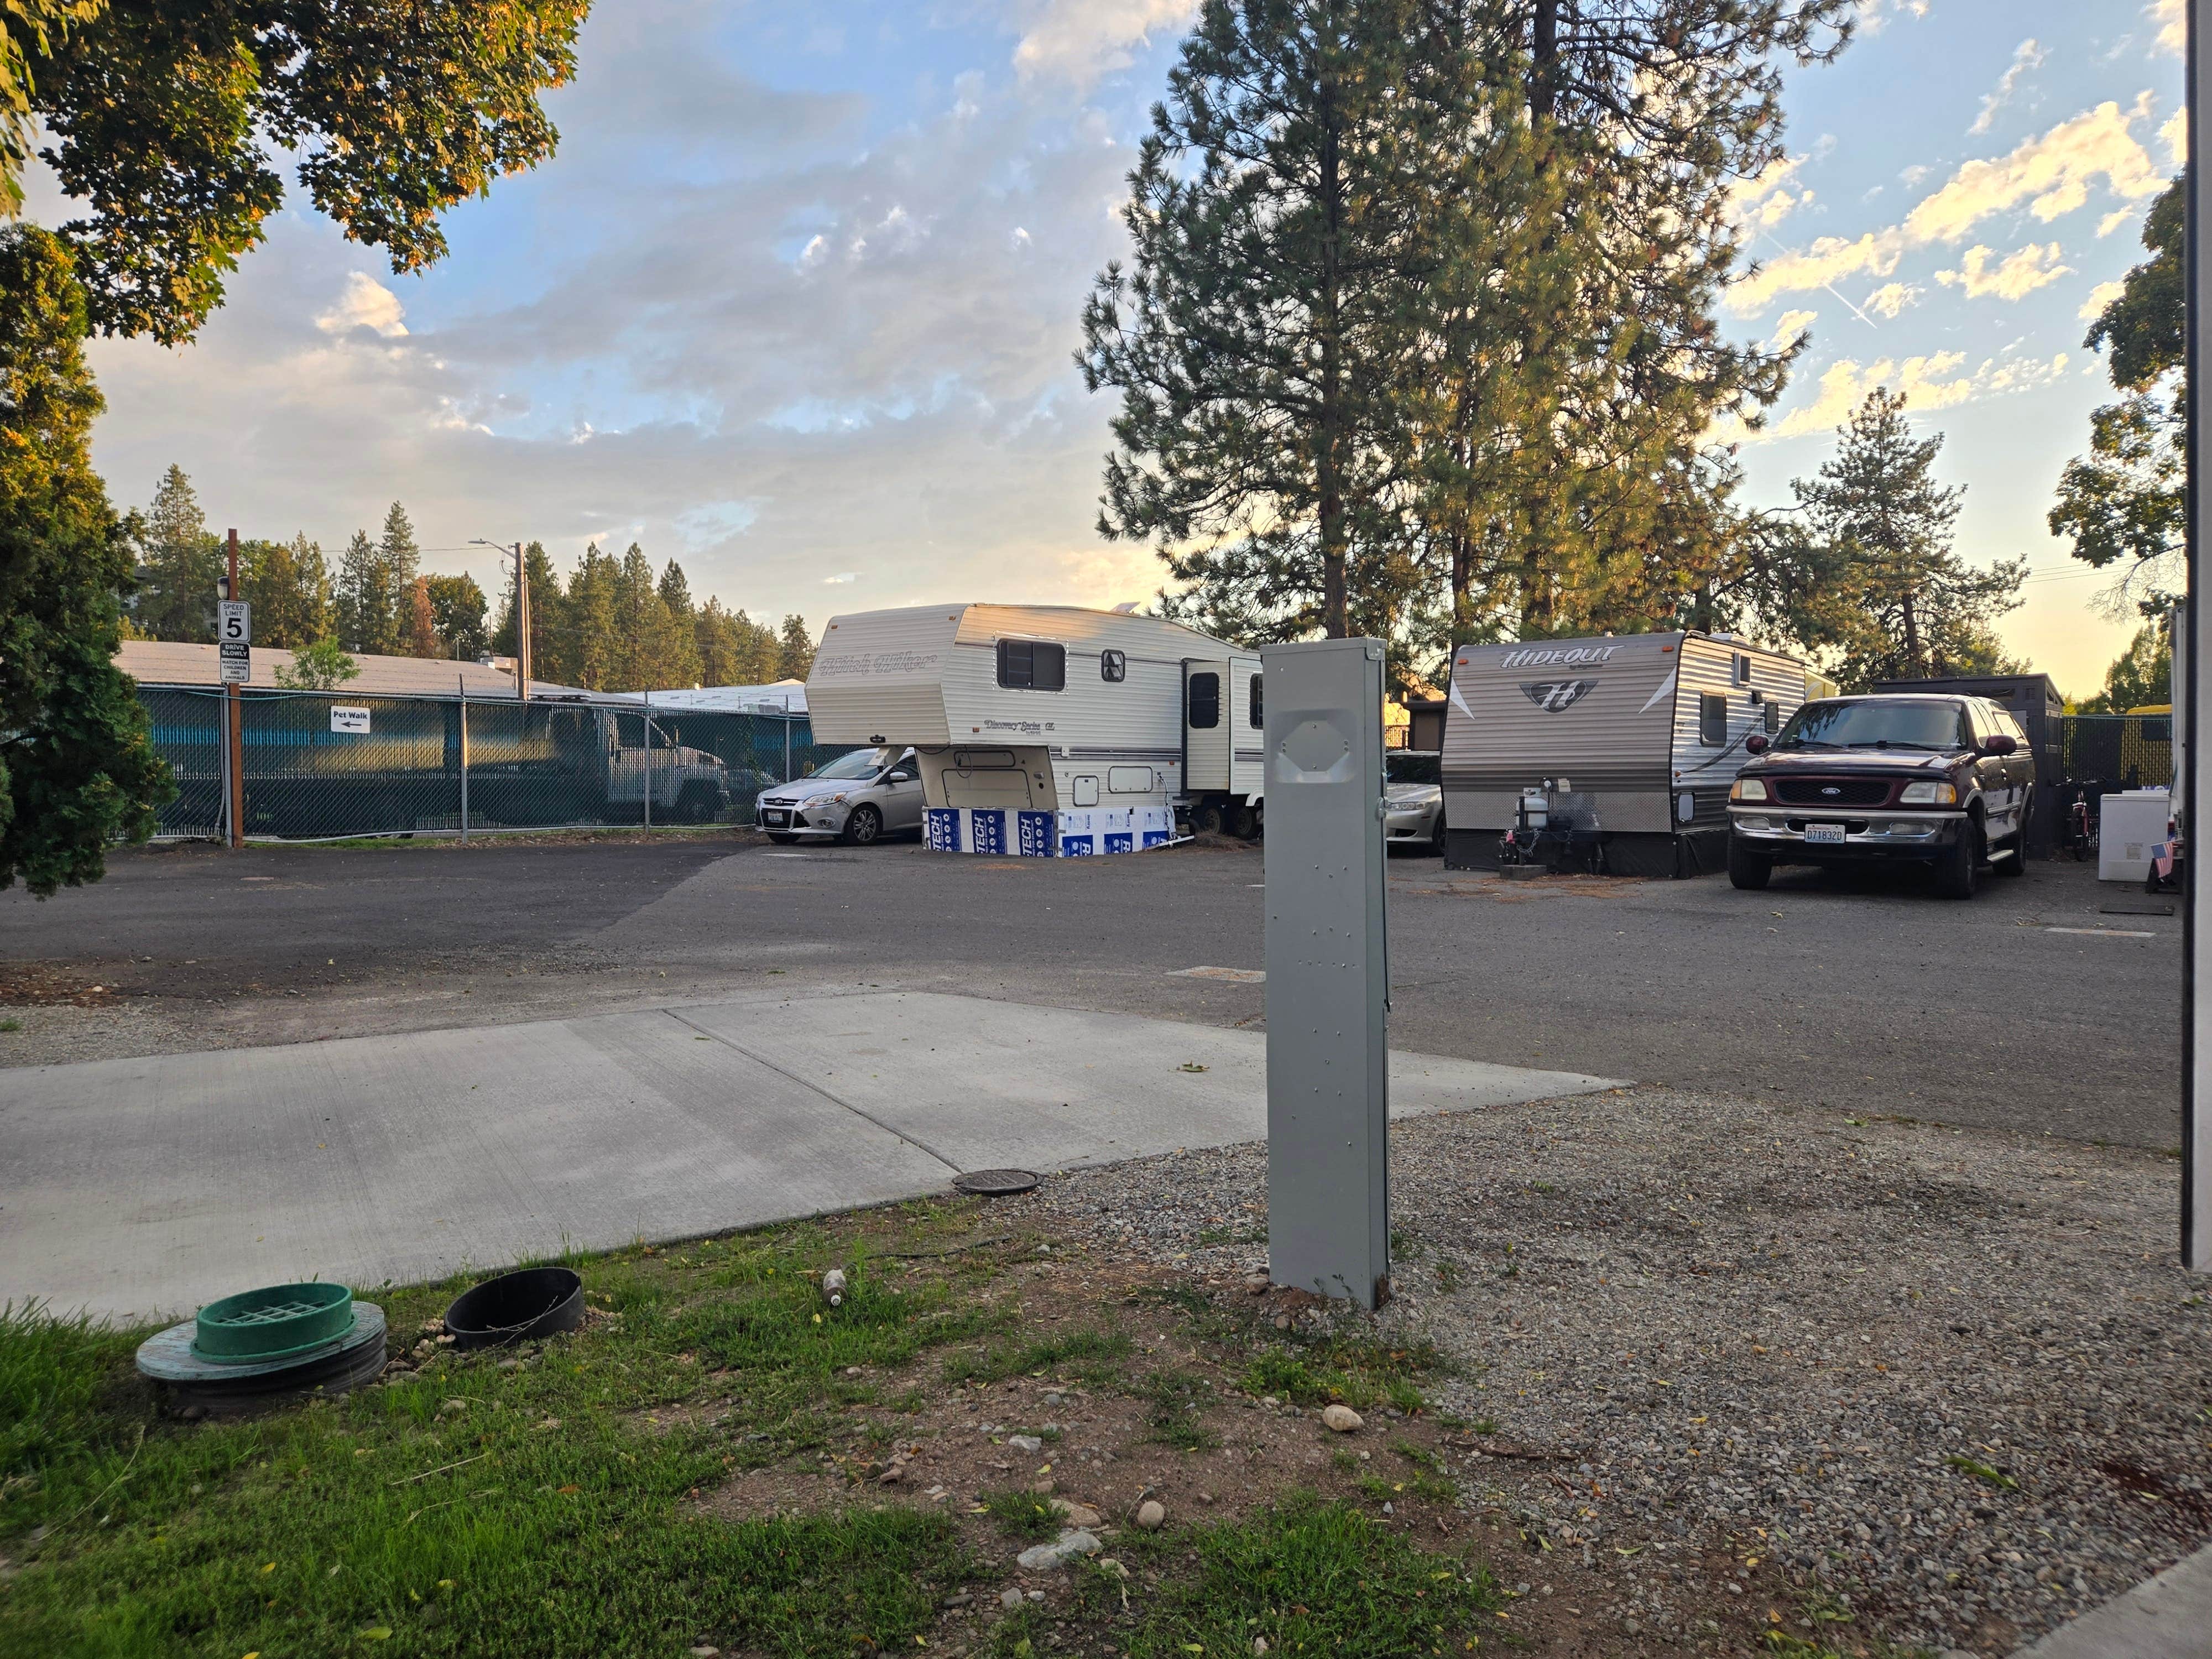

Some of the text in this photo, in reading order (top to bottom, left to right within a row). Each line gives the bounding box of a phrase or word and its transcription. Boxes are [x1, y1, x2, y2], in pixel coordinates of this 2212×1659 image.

[227, 617, 242, 638] 5
[818, 651, 938, 676] Hitch Hiker
[1500, 645, 1626, 668] HIDEOUT
[984, 719, 1021, 731] Discovery
[1020, 721, 1040, 731] Series
[1807, 831, 1842, 840] D71832D
